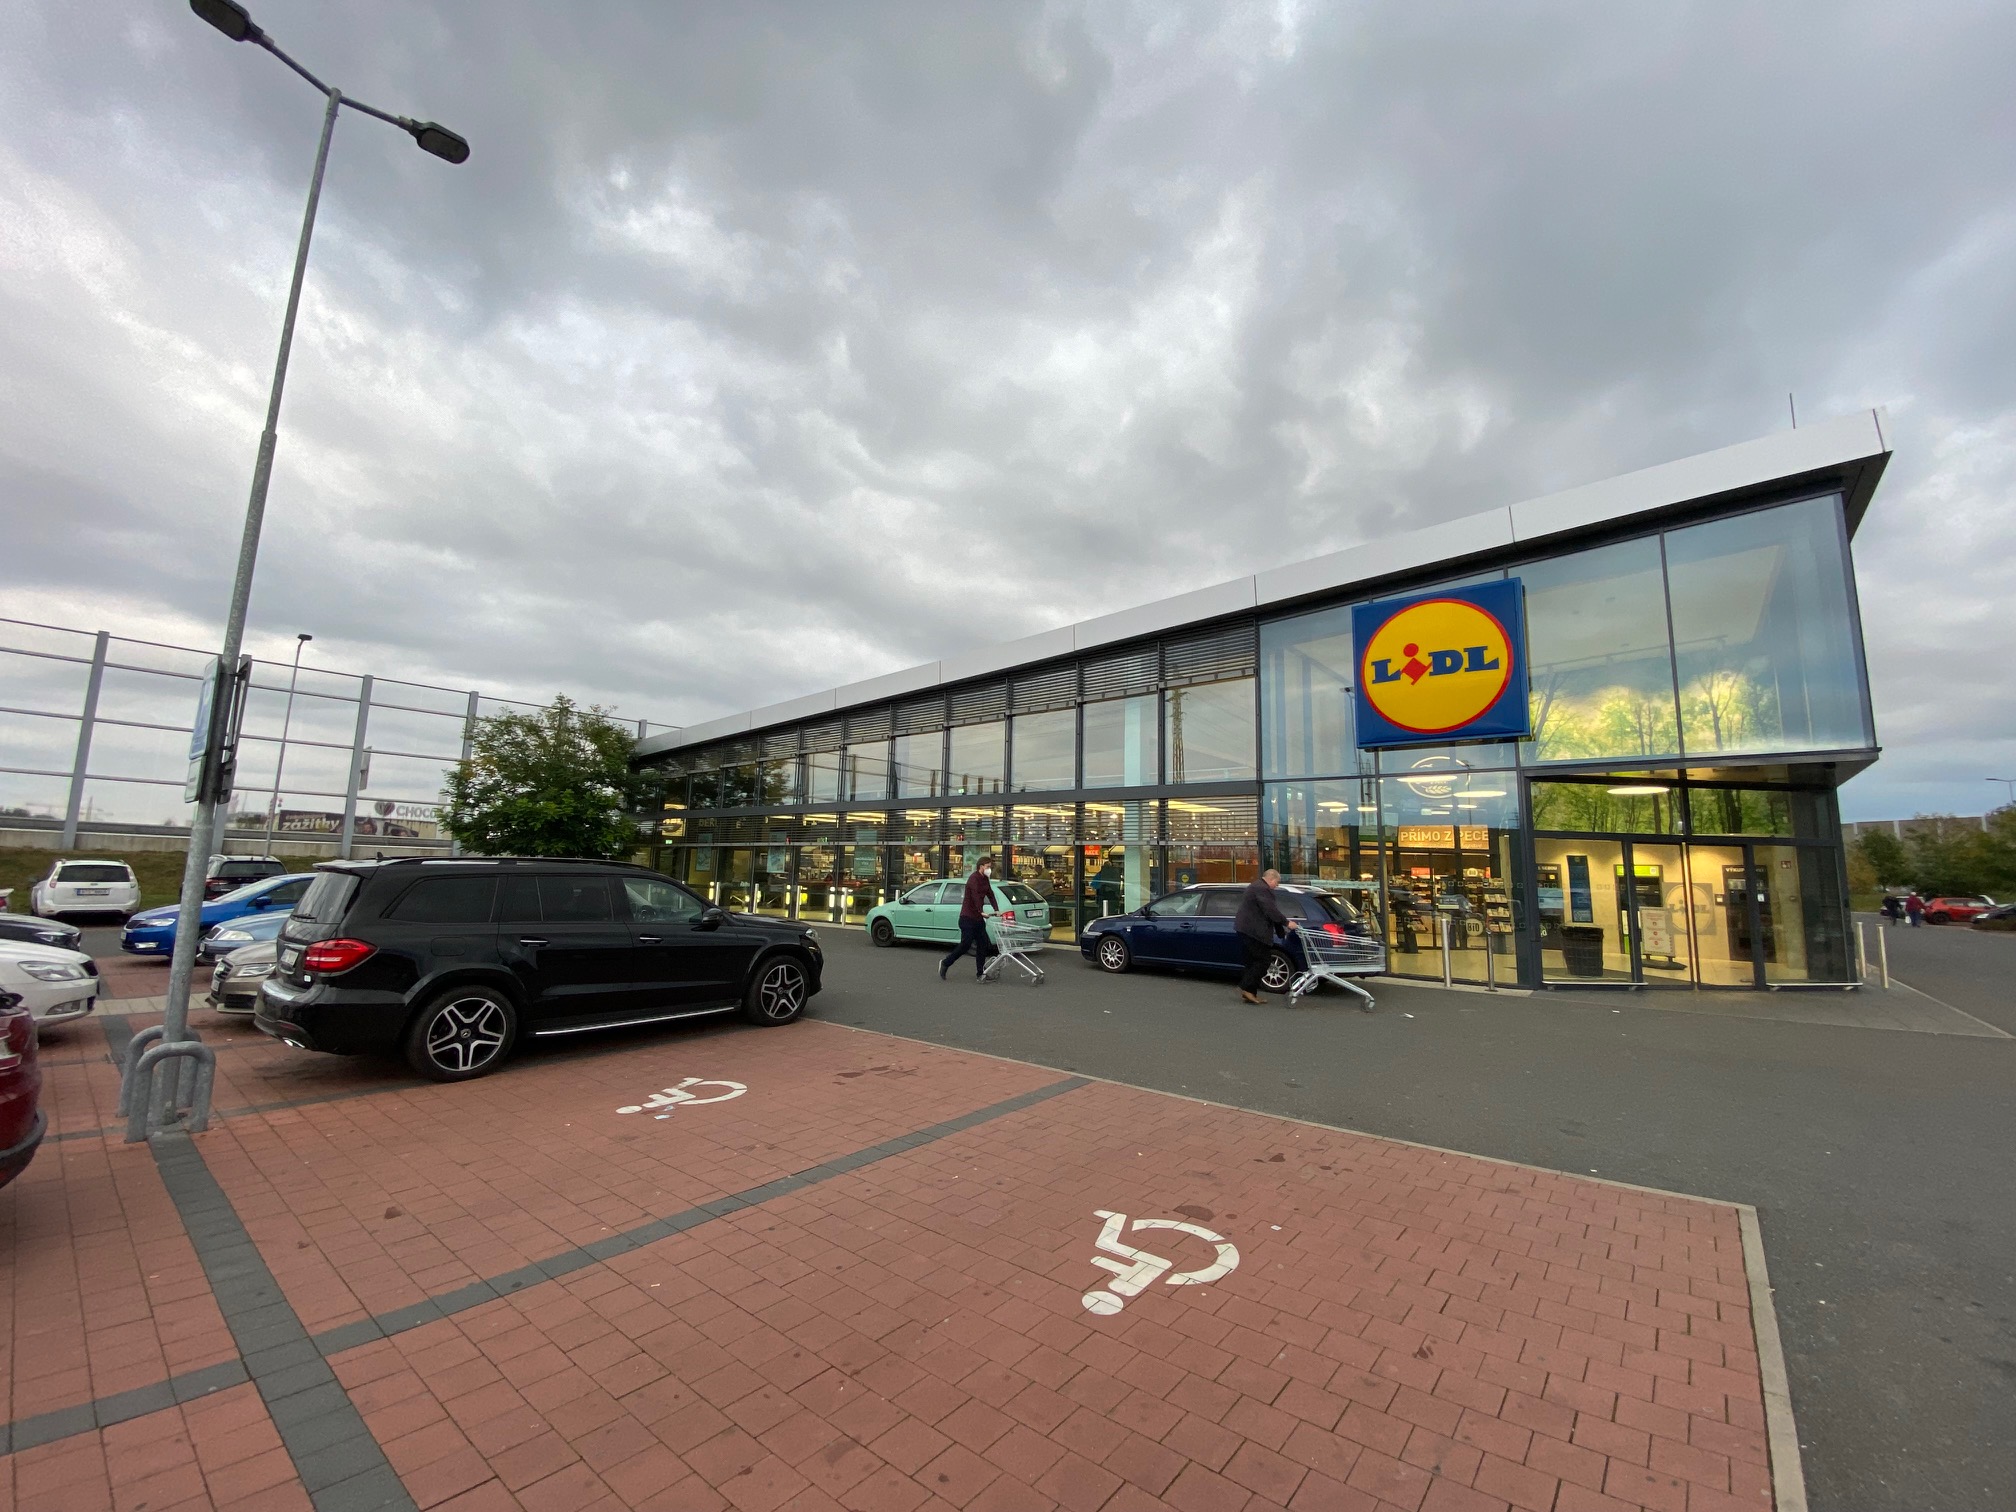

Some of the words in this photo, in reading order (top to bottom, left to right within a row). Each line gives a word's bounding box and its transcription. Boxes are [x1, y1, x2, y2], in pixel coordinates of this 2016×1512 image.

[282, 816, 339, 831] zážitky
[1401, 828, 1440, 842] PŘÍMO
[1444, 831, 1452, 841] Z
[1459, 831, 1489, 841] PECE
